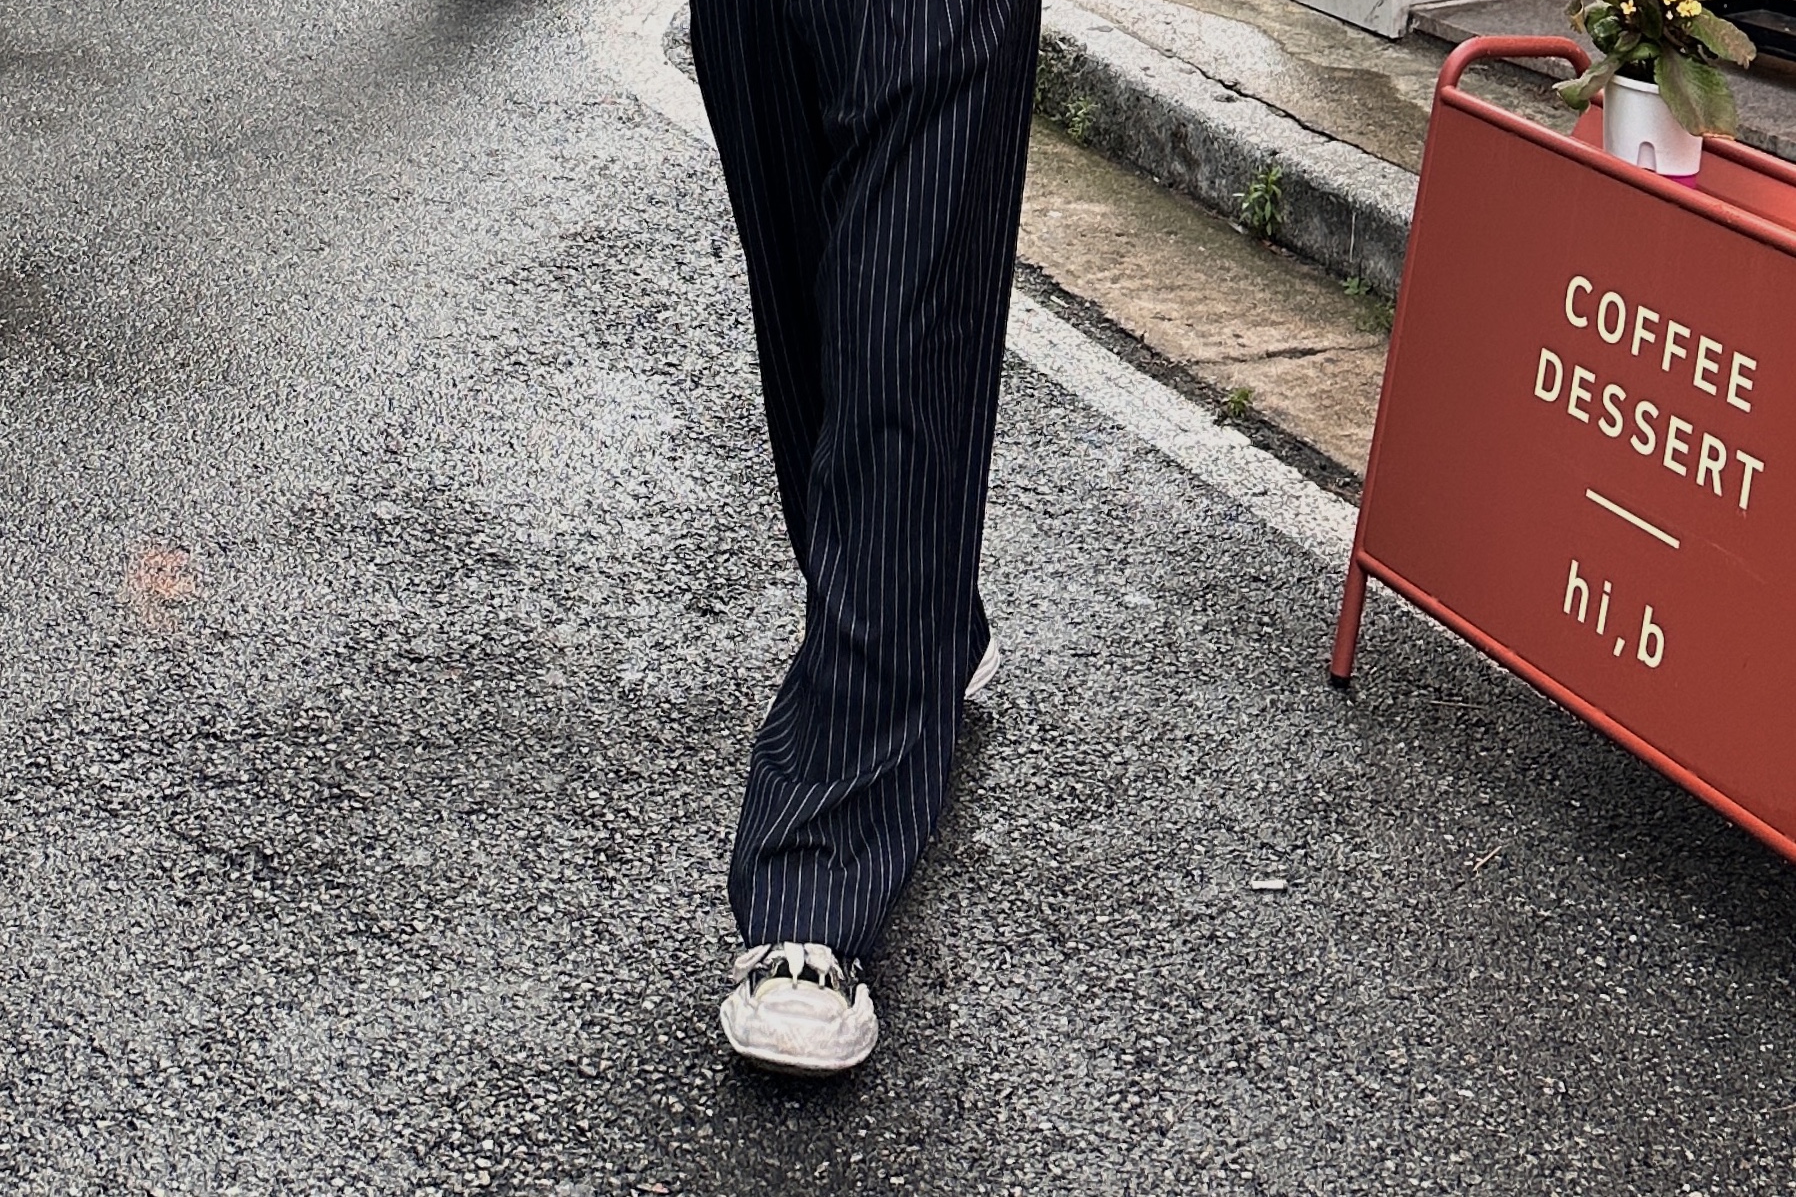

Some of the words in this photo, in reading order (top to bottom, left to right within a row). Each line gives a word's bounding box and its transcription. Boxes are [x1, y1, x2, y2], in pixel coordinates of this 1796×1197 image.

[1564, 275, 1757, 413] COFFEE
[1533, 347, 1765, 511] DESSERT
[1562, 558, 1666, 669] hi,b
